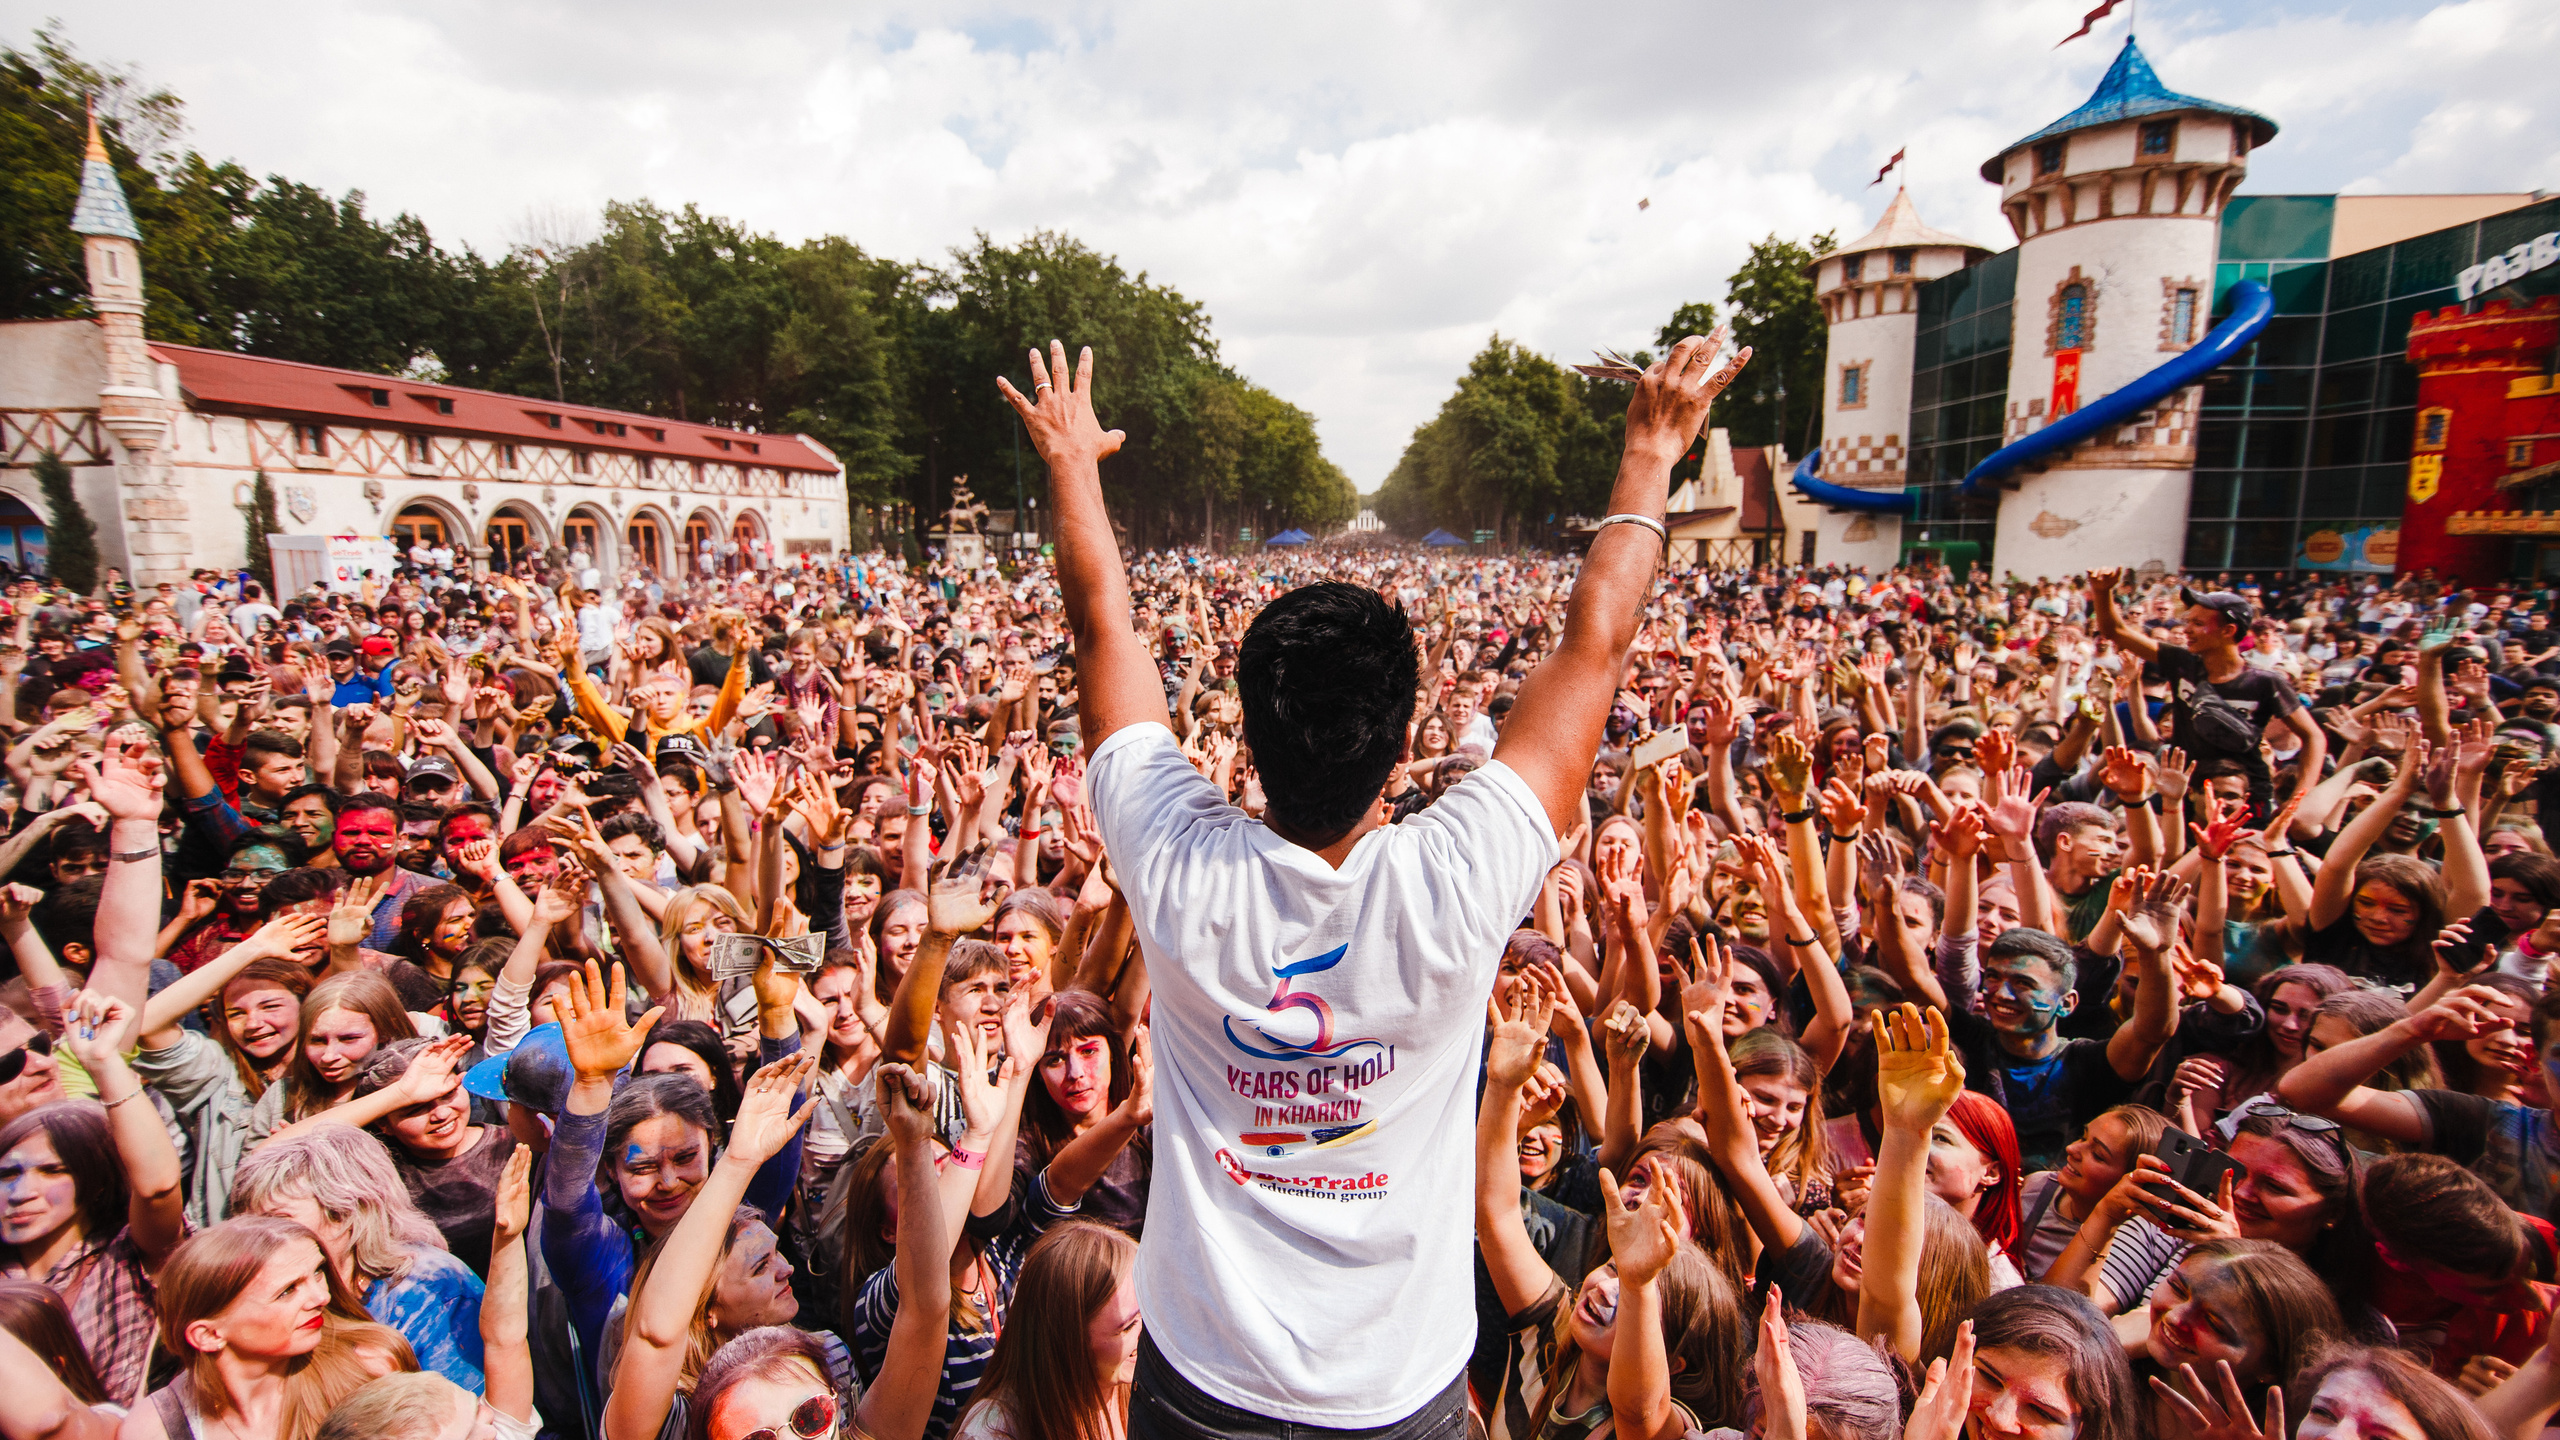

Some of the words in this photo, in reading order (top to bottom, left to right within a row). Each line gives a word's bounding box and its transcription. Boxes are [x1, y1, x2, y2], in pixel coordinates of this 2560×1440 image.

[668, 737, 693, 750] NYC
[1227, 1064, 1299, 1099] YEARS
[1307, 1065, 1336, 1095] OF
[1343, 1044, 1394, 1093] HOLI
[1254, 1105, 1272, 1126] IN
[1278, 1097, 1361, 1125] KHARKIV
[1259, 1183, 1335, 1200] education
[1340, 1190, 1387, 1203] group
